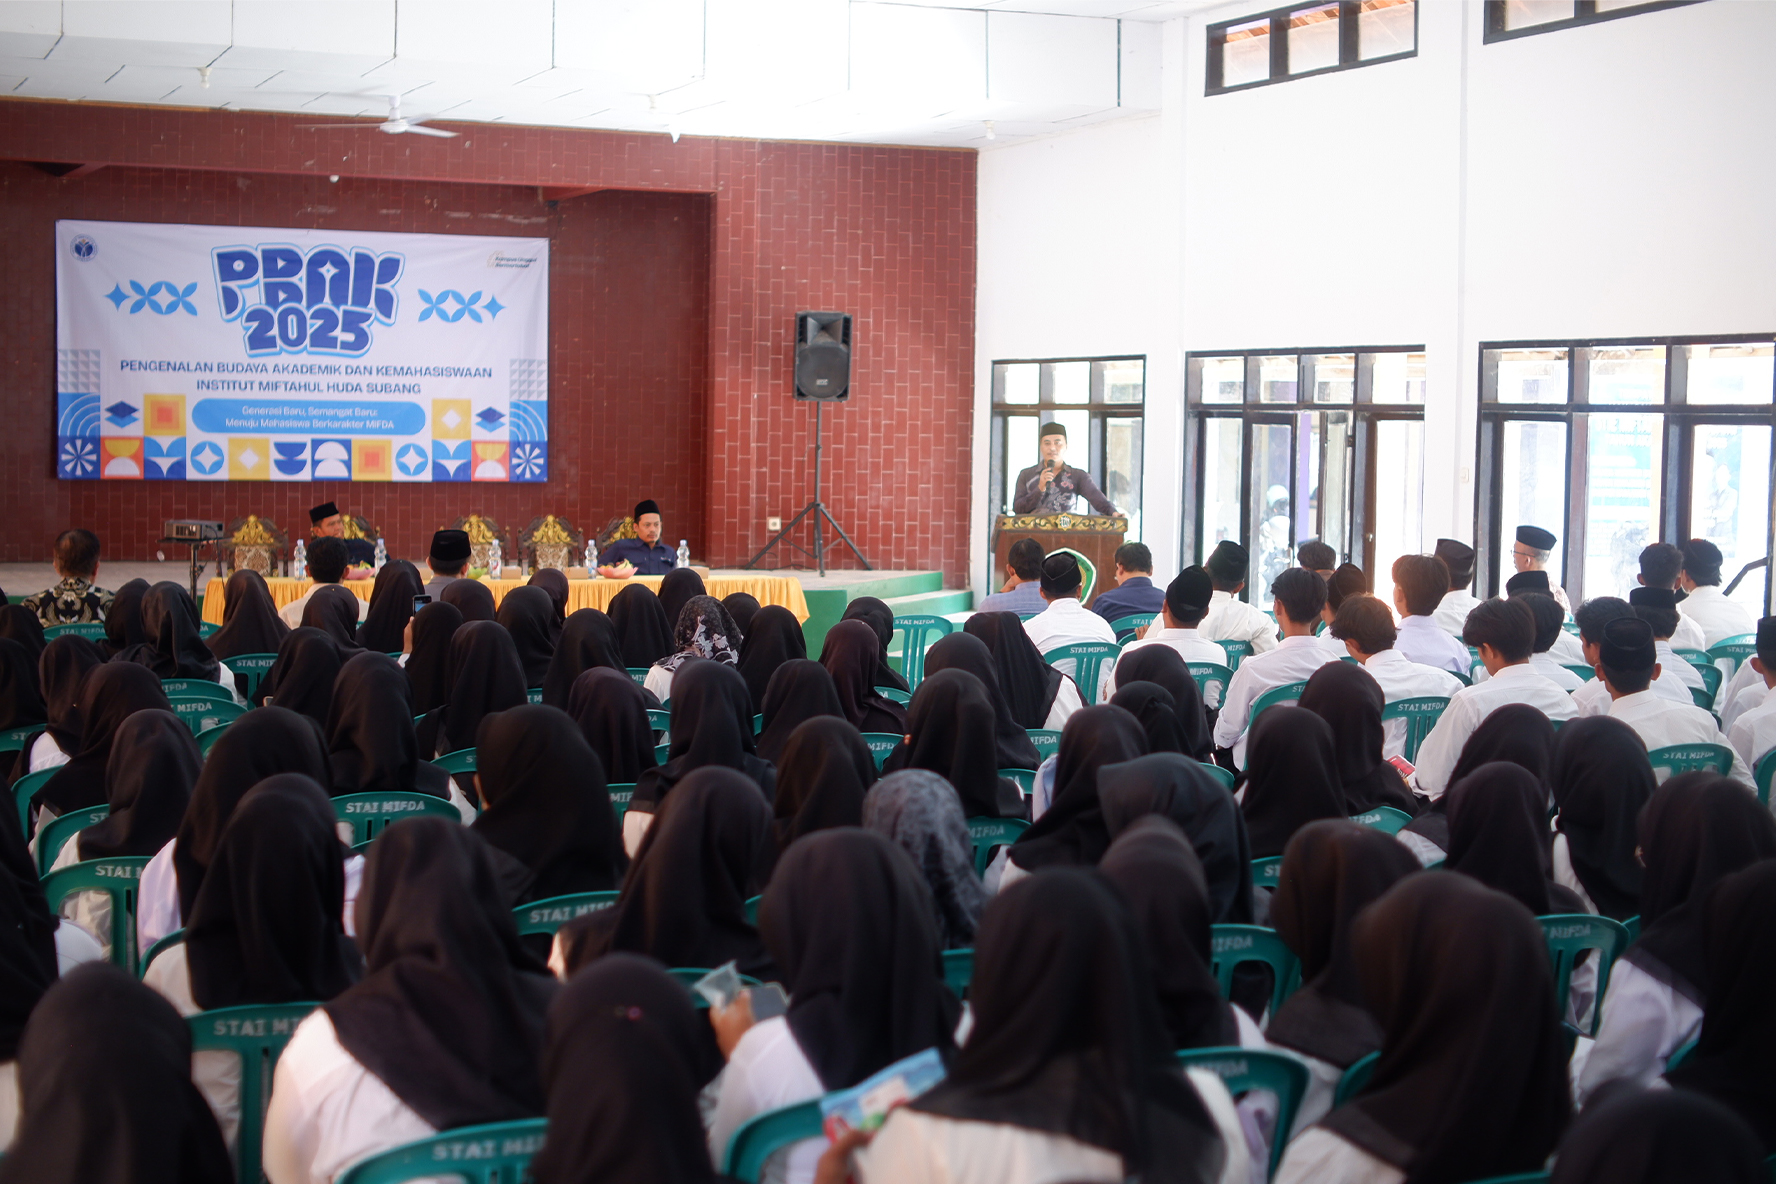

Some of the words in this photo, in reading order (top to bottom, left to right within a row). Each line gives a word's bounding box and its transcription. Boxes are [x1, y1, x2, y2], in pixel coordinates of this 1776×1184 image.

[214, 246, 402, 322] PBAK
[243, 304, 375, 355] 2025
[120, 360, 213, 373] PENGENALAN
[217, 362, 268, 374] BUDAYA
[272, 363, 341, 376] AKADEMIK
[345, 364, 373, 377] DAN
[376, 365, 492, 378] KEMAHASISWAAN
[196, 379, 256, 391] INSTITUT
[258, 380, 323, 392] MIFTAHUL
[327, 382, 363, 393] HUDA
[366, 383, 421, 394] SUBANG
[242, 403, 282, 413] Generasi
[308, 406, 353, 418] Semangat
[225, 418, 259, 429] Menuju
[260, 418, 310, 429] Mahasiswa
[312, 419, 364, 429] Berkarakter
[366, 420, 395, 429] MIFDA
[236, 660, 256, 668] STAI
[161, 682, 187, 693] IFDA
[177, 702, 212, 712] MIFDA
[1398, 703, 1420, 711] STAI
[1421, 702, 1445, 711] MIFDA
[867, 742, 895, 752] MIFD
[610, 791, 633, 802] MIF
[346, 802, 379, 813] STAI
[382, 801, 425, 813] MIFDA
[95, 864, 132, 878] STAI
[530, 905, 571, 923] STAI
[213, 1019, 265, 1036] STAI
[432, 1141, 497, 1160] STAI
